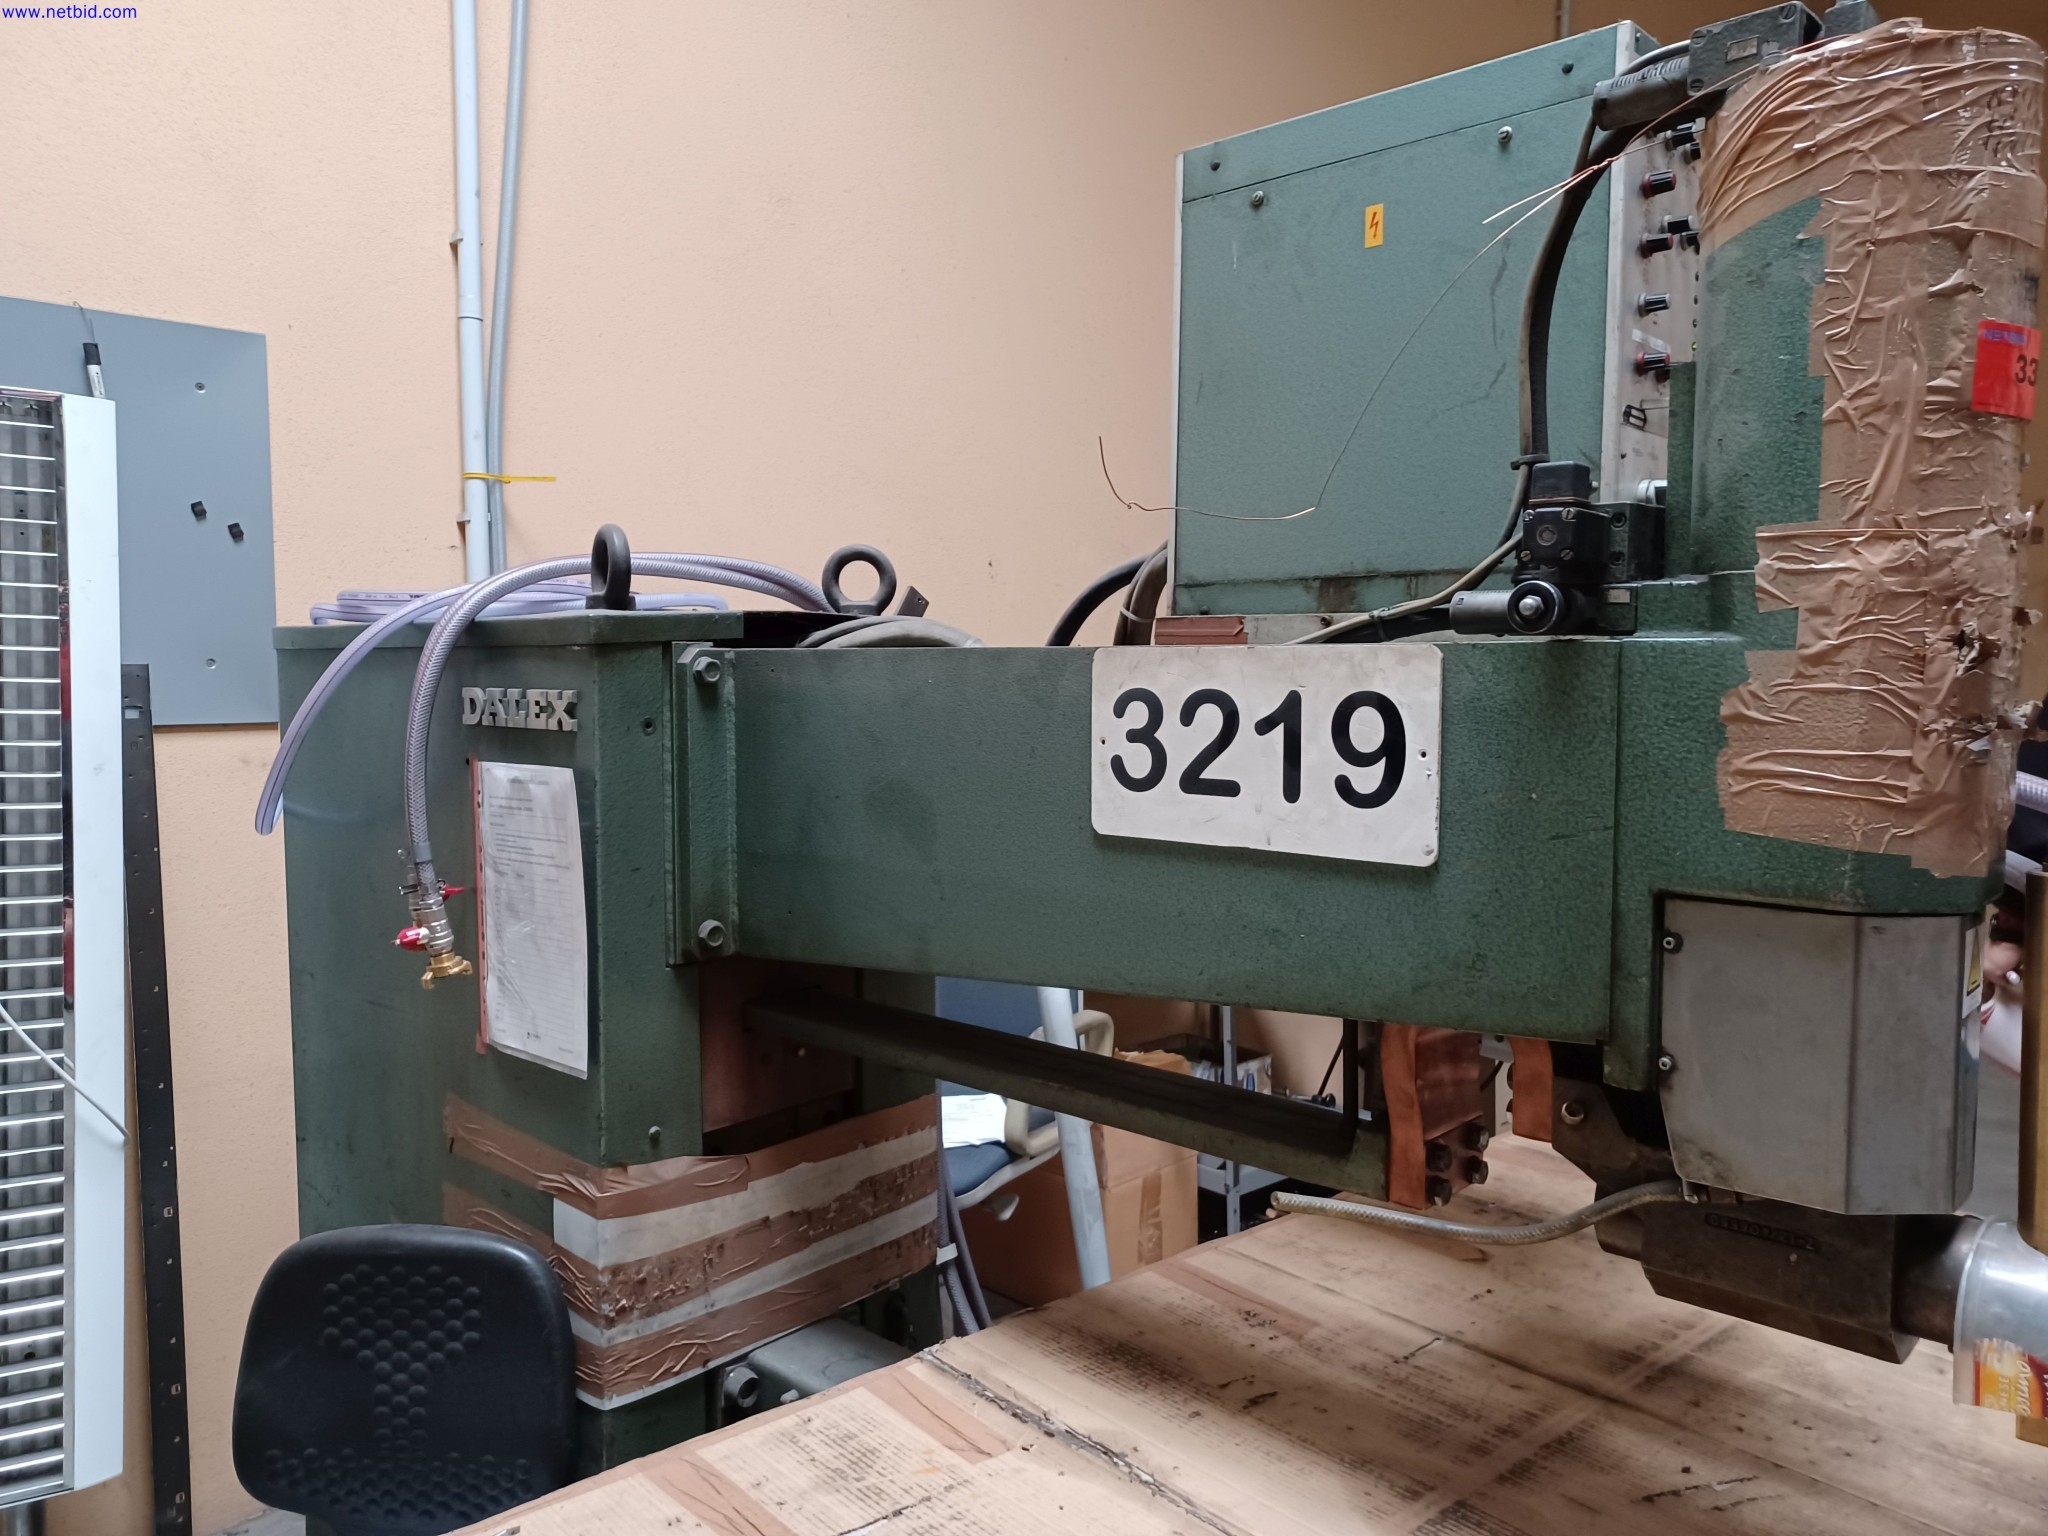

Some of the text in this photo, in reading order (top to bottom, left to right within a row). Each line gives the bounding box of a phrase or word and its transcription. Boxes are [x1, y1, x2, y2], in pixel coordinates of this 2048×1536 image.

[462, 687, 578, 732] DALEX
[1110, 687, 1407, 809] 3219
[1999, 1375, 2009, 1412] NESE
